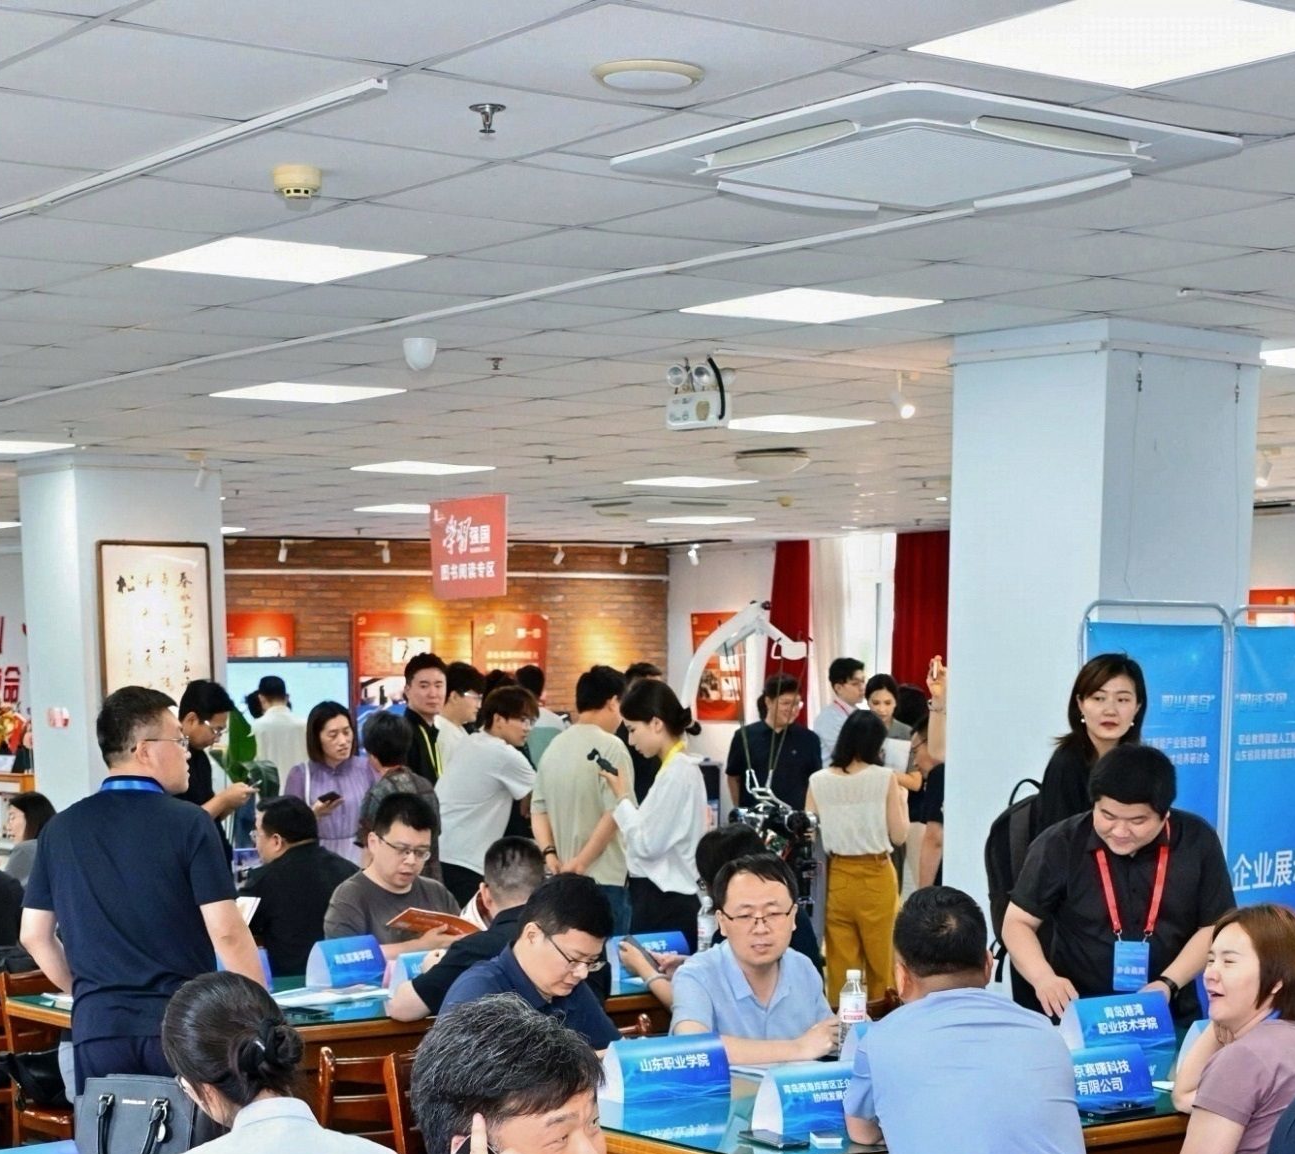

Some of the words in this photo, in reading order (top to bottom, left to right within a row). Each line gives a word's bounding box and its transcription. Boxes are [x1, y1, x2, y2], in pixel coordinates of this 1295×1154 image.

[1103, 1003, 1144, 1019] 青岛港湾
[1097, 1016, 1159, 1036] 职业技术学院
[639, 1053, 710, 1073] 山东职业学院
[1077, 1077, 1124, 1095] 有限公司
